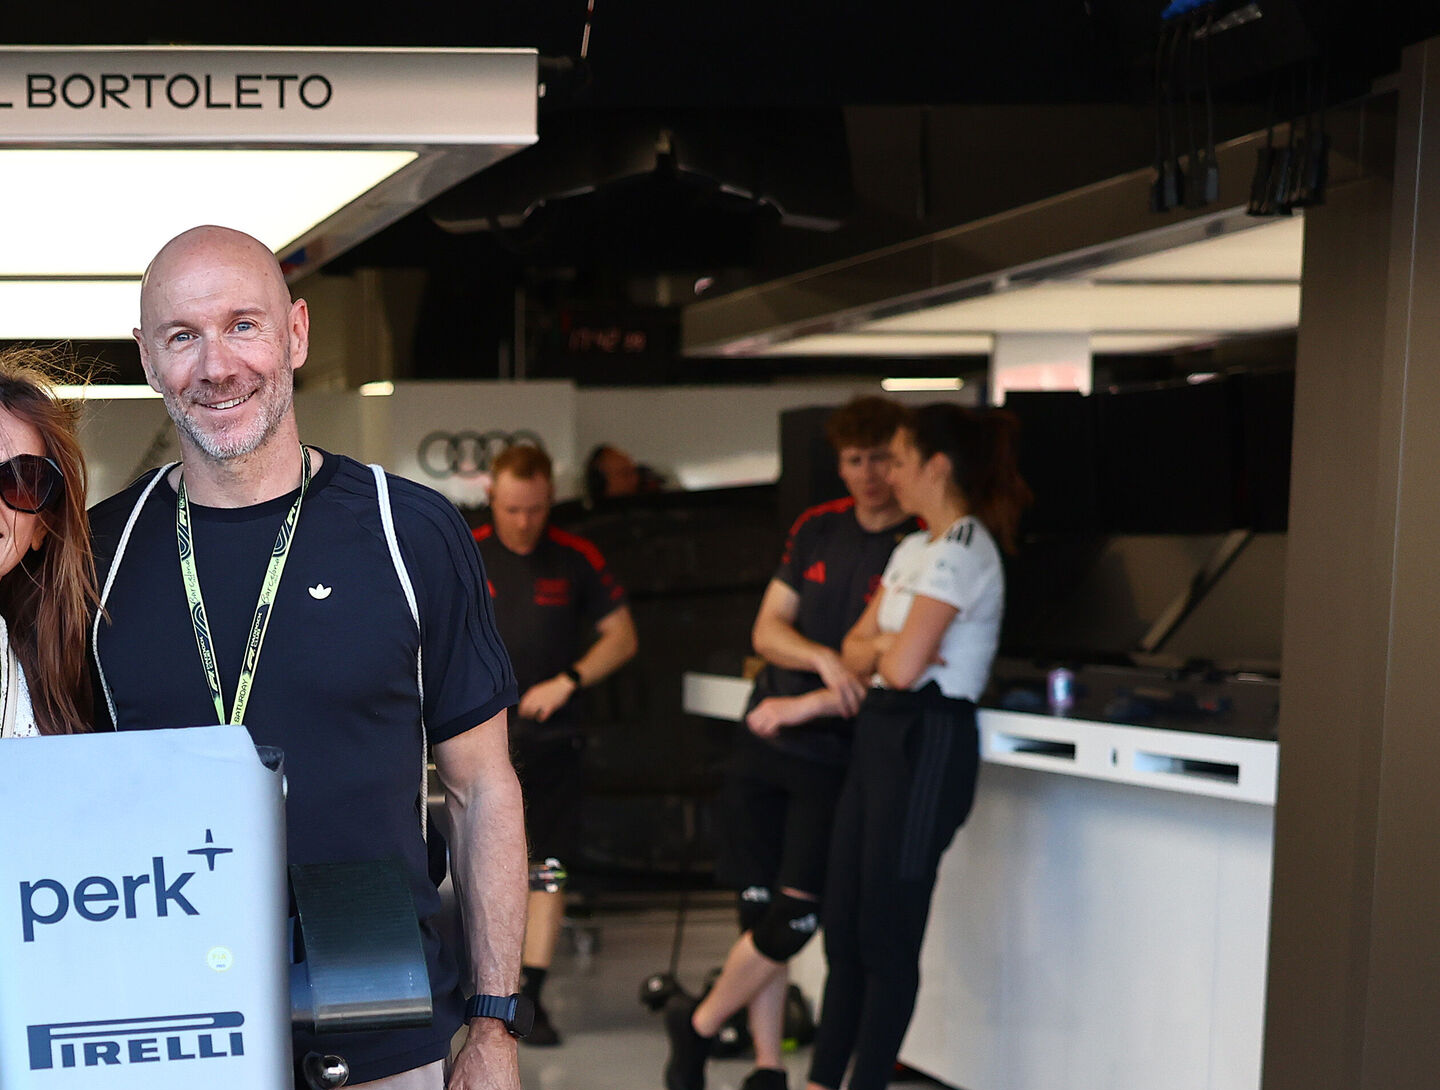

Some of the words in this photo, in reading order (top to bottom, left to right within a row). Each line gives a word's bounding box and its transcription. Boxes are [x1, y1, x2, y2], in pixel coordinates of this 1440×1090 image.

[26, 73, 334, 109] BORTOLETO
[234, 678, 248, 722] SATURDAY
[19, 856, 201, 943] perk
[26, 1010, 246, 1071] PIRELLI
